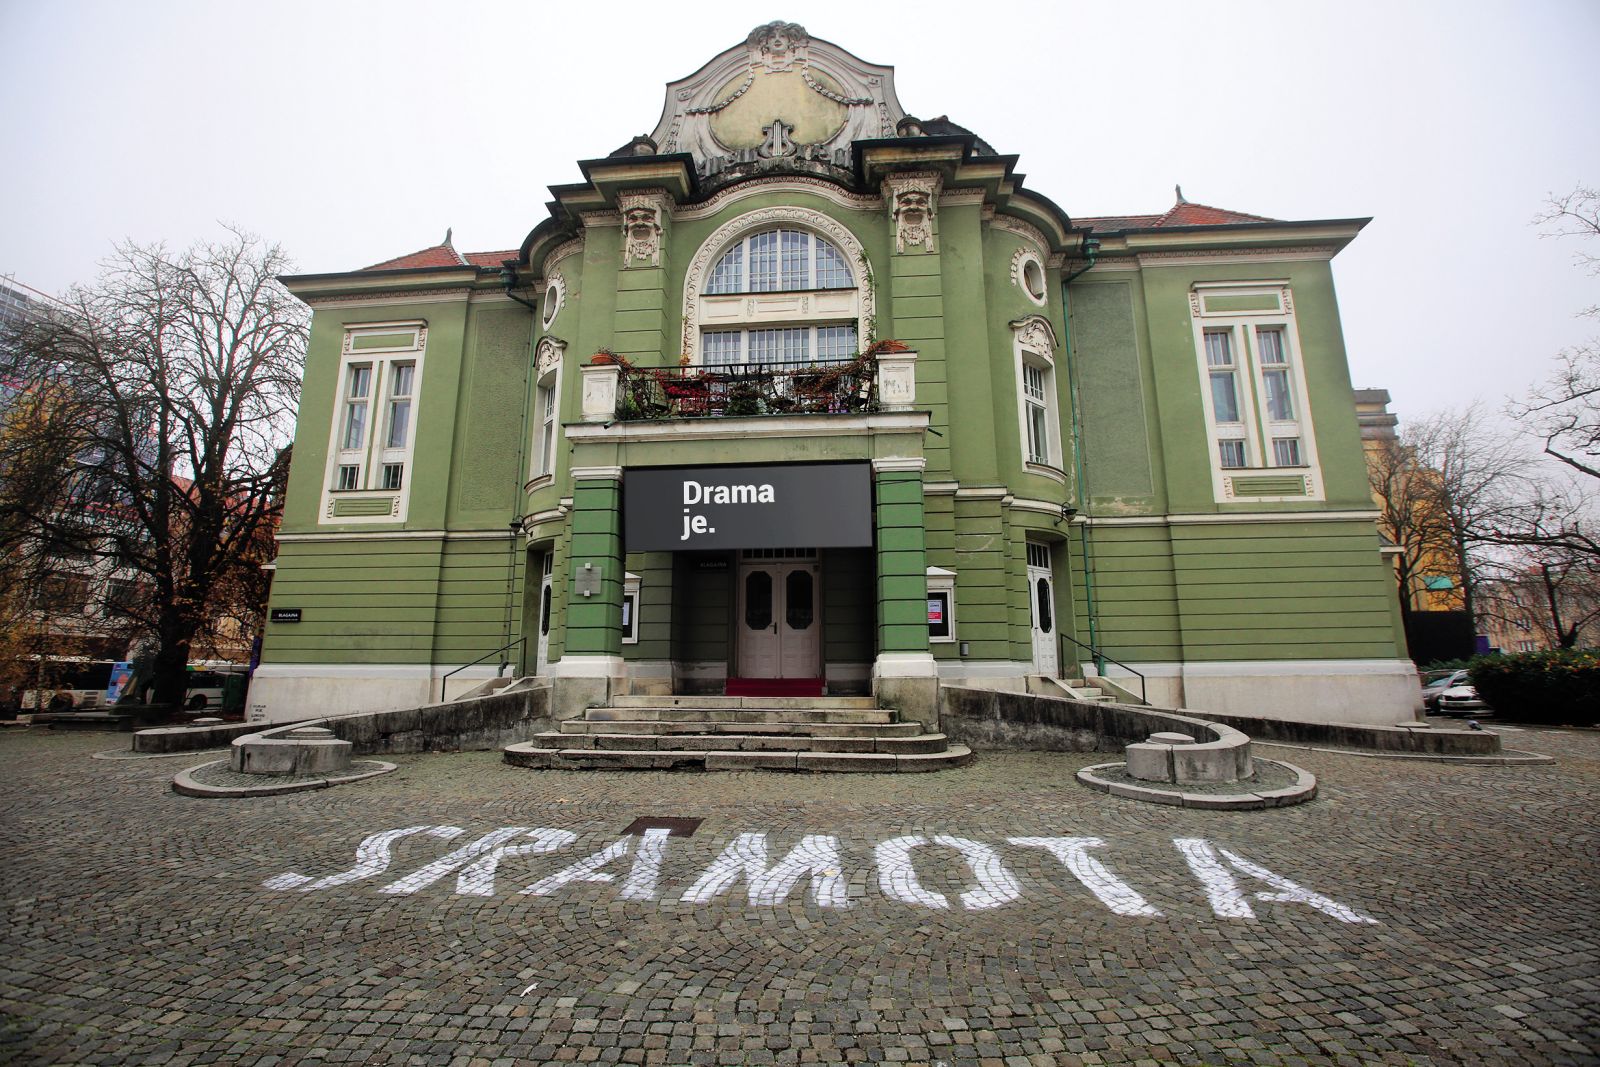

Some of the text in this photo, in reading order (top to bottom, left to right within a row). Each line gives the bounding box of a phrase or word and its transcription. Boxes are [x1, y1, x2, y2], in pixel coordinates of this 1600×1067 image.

[683, 480, 776, 505] Drama
[680, 508, 716, 541] je.
[262, 825, 1380, 925] SRAMOTA
